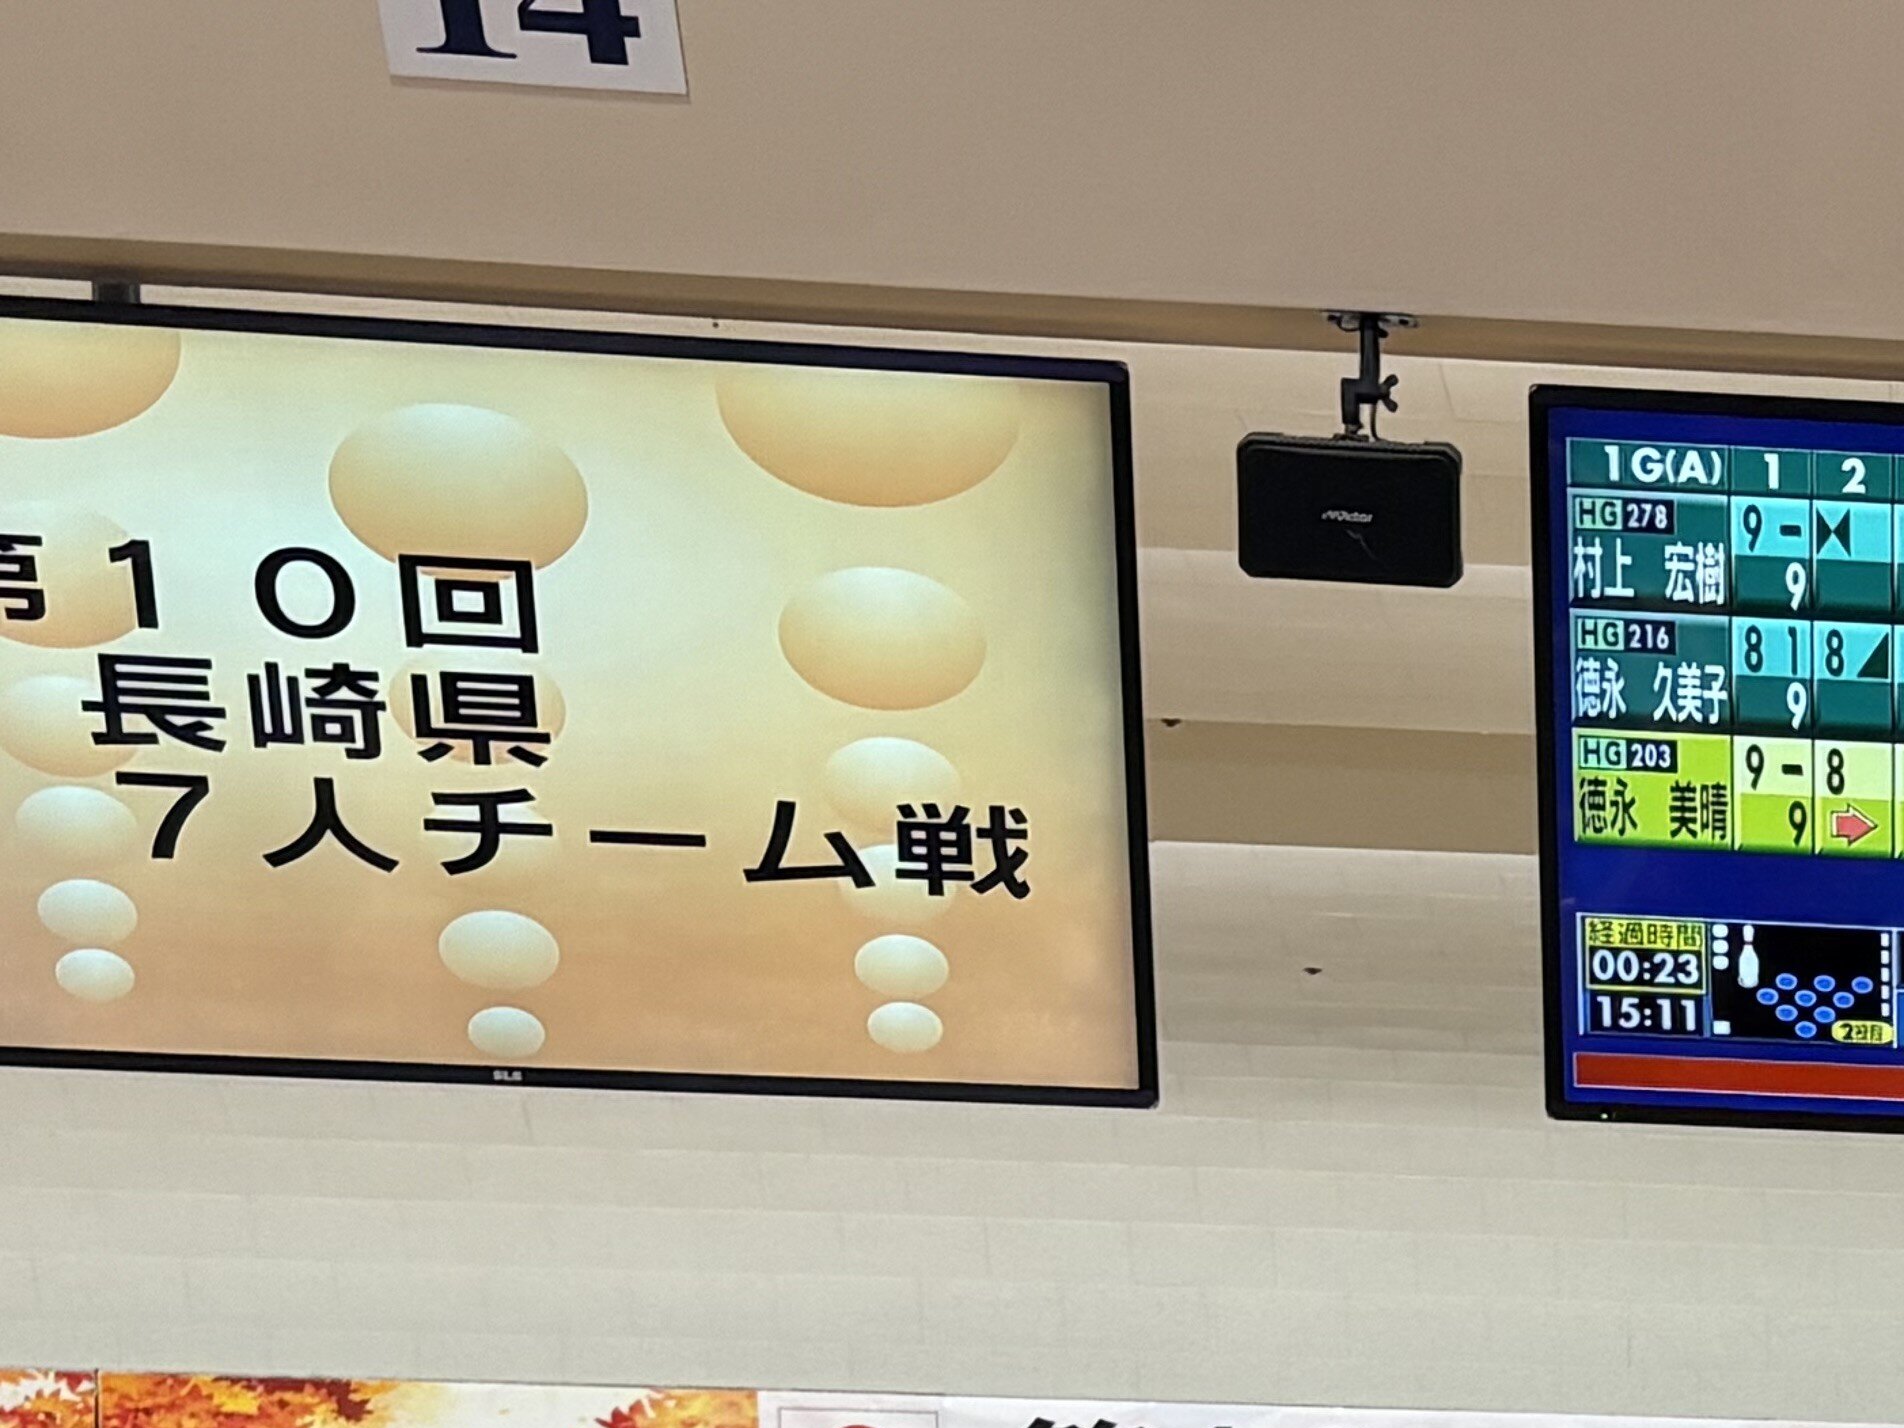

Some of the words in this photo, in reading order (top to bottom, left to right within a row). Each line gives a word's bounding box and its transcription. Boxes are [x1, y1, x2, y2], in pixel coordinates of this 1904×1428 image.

[1764, 454, 1780, 490] 1
[1841, 458, 1866, 495] 2
[1573, 536, 1635, 599] 村上
[1664, 542, 1725, 605] 宏樹
[81, 652, 551, 769] 長崎県
[1576, 656, 1627, 720] 徳永
[1653, 661, 1728, 725] 久美子
[113, 769, 1033, 902] 7人チーム戦
[1579, 776, 1639, 836] 徳永
[1669, 780, 1729, 841] 美晴
[1591, 951, 1700, 985] 00:23
[1597, 995, 1698, 1032] 15:11
